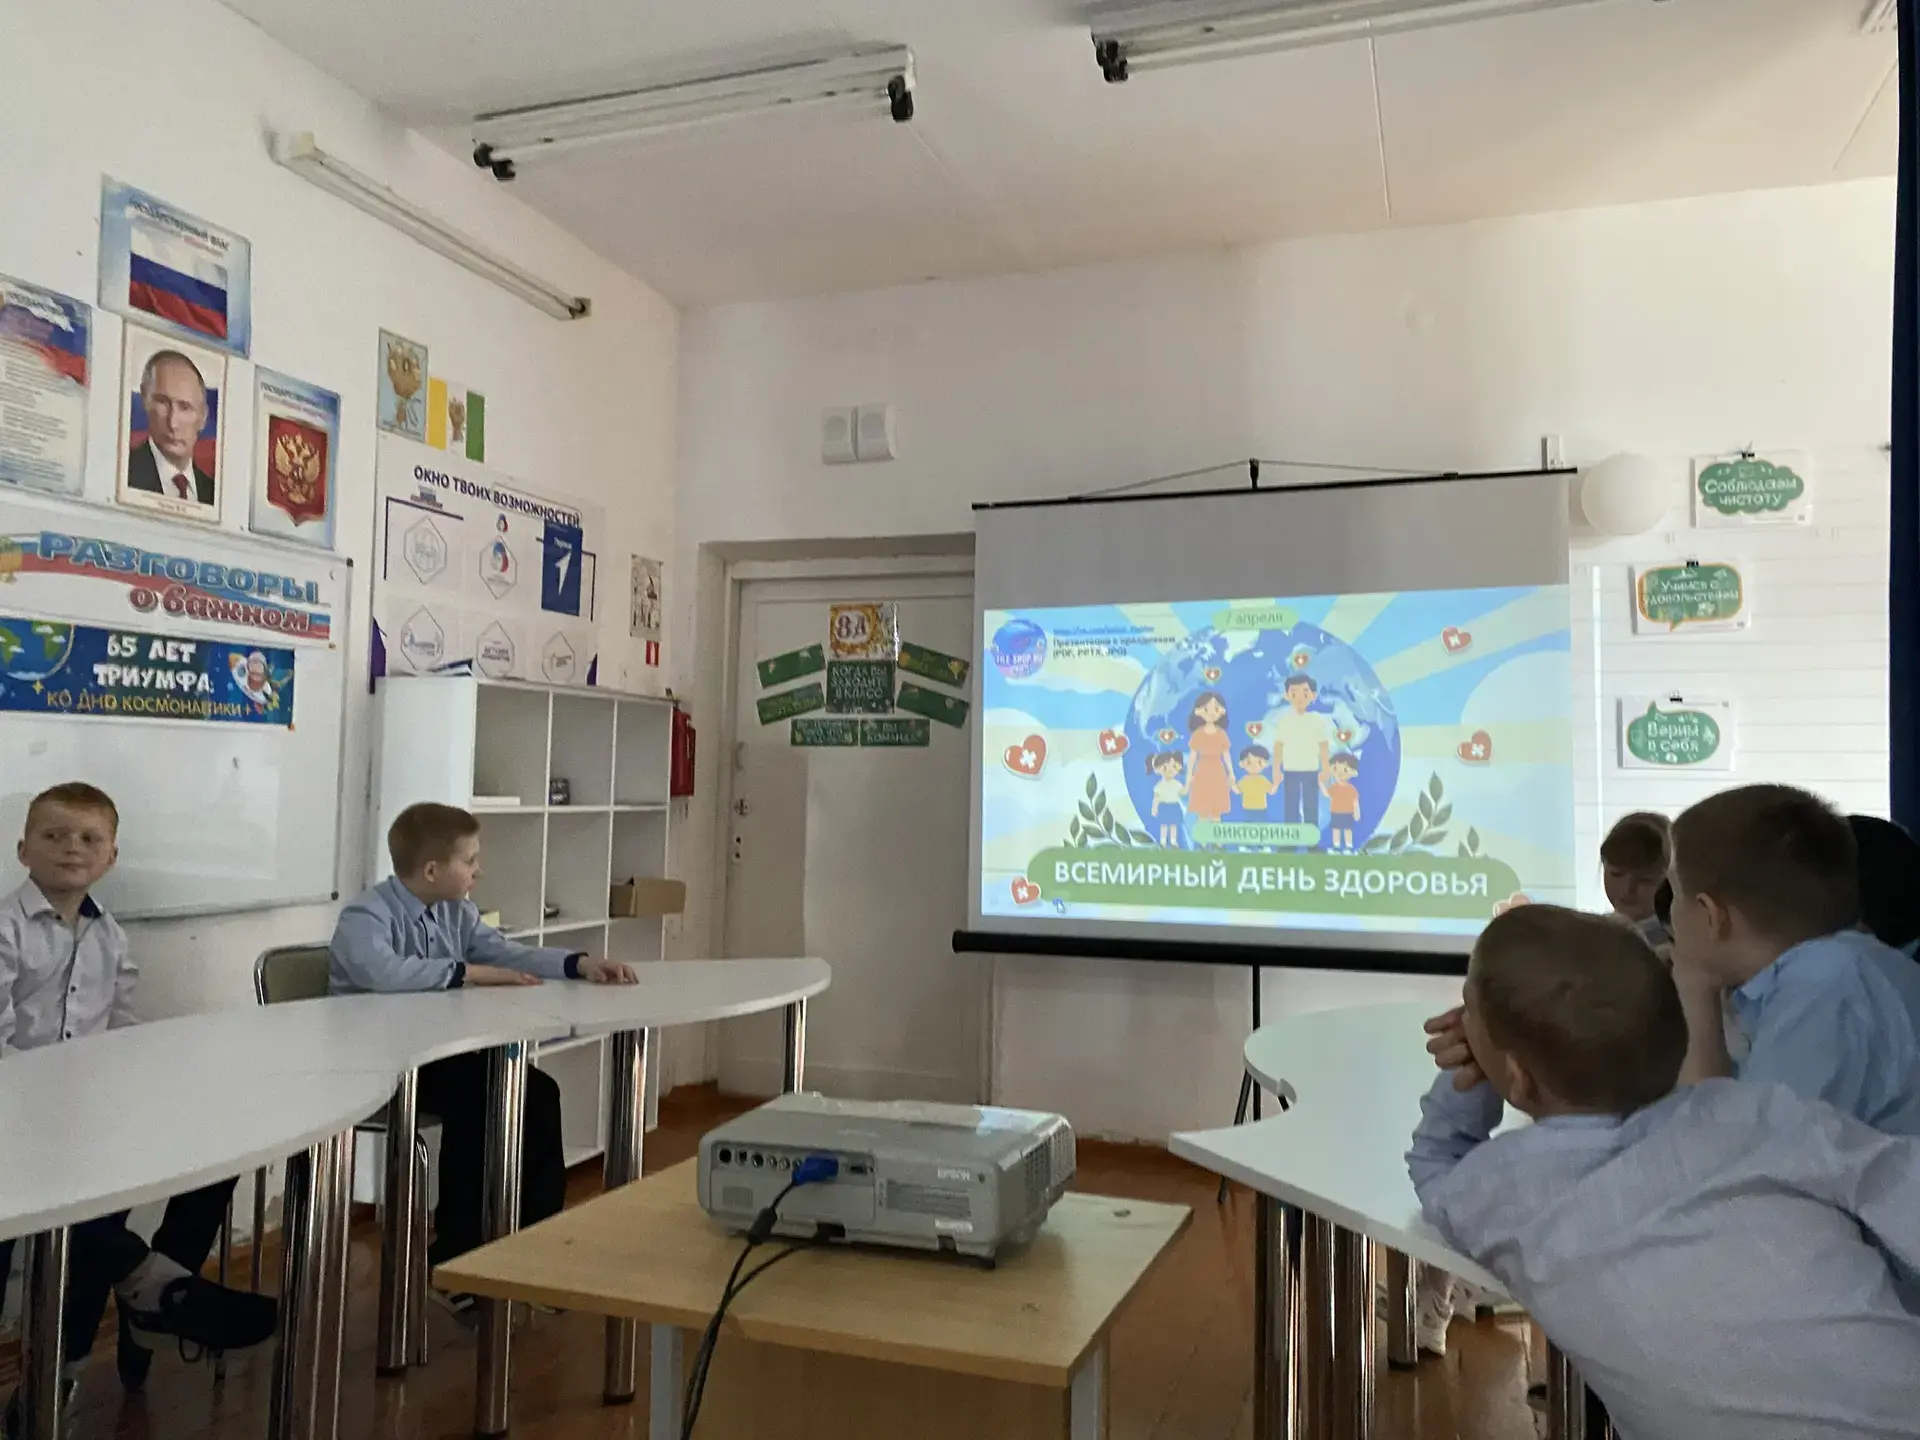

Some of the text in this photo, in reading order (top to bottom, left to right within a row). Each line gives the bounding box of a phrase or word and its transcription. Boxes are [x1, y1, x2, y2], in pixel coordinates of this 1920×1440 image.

[414, 465, 449, 488] ОКНО
[452, 477, 491, 502] ТВОИХ
[493, 491, 580, 528] ВОЗМОЖНОСТЕЙ
[1704, 478, 1797, 494] Соблюдаем
[1720, 492, 1782, 507] чистоту
[37, 531, 319, 604] РАЗГОВОРЫ
[163, 583, 310, 633] важном
[107, 634, 197, 664] 65 ЛЕТ
[47, 688, 72, 708] КО
[1647, 721, 1699, 740] Верим
[1660, 737, 1699, 753] себя
[1055, 859, 1488, 899] ВСЕМИРНЫЙ ДЕНЬ ЗДОРОВЬЯ
